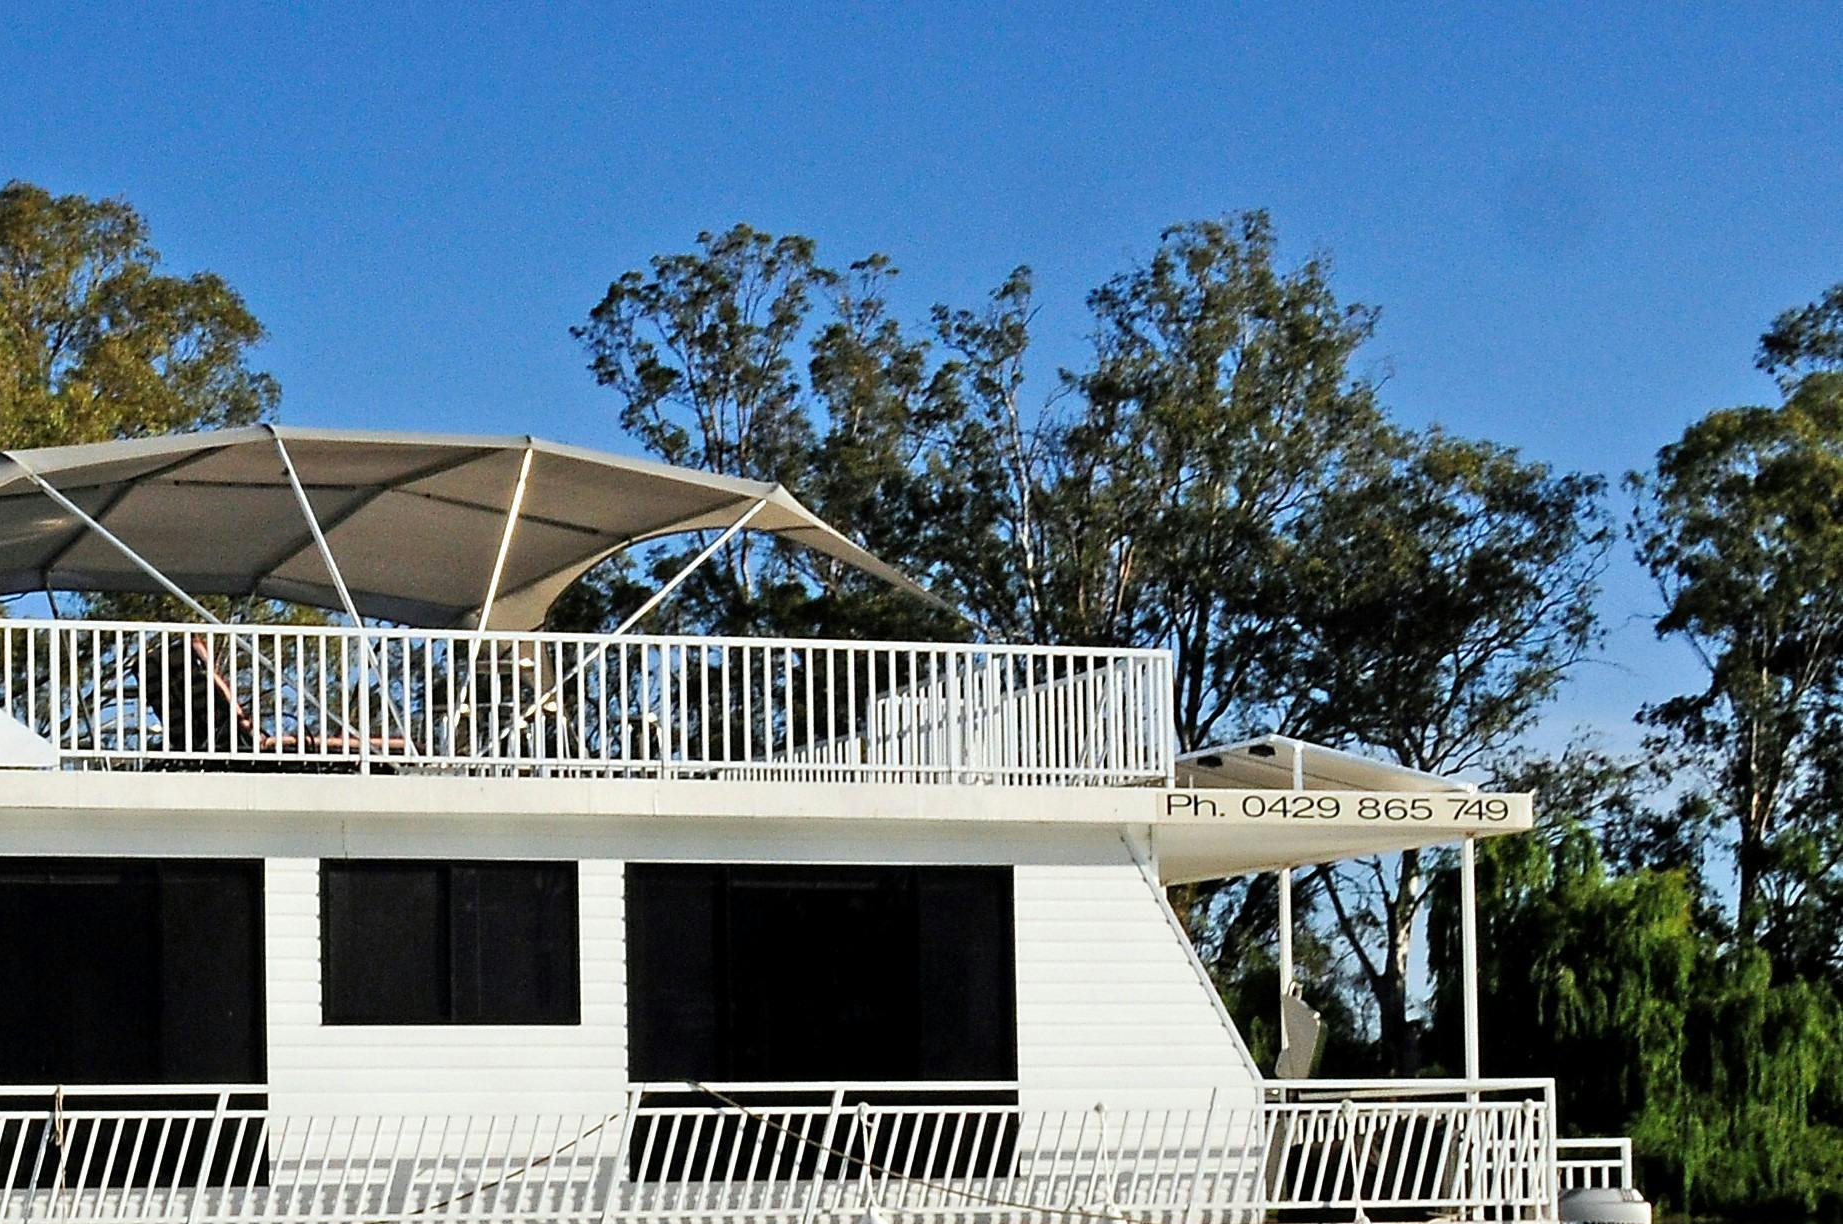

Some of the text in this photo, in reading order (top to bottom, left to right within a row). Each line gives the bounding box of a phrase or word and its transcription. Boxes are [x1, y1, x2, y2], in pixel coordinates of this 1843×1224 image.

[1166, 794, 1510, 822] Ph. 0429 865 749
